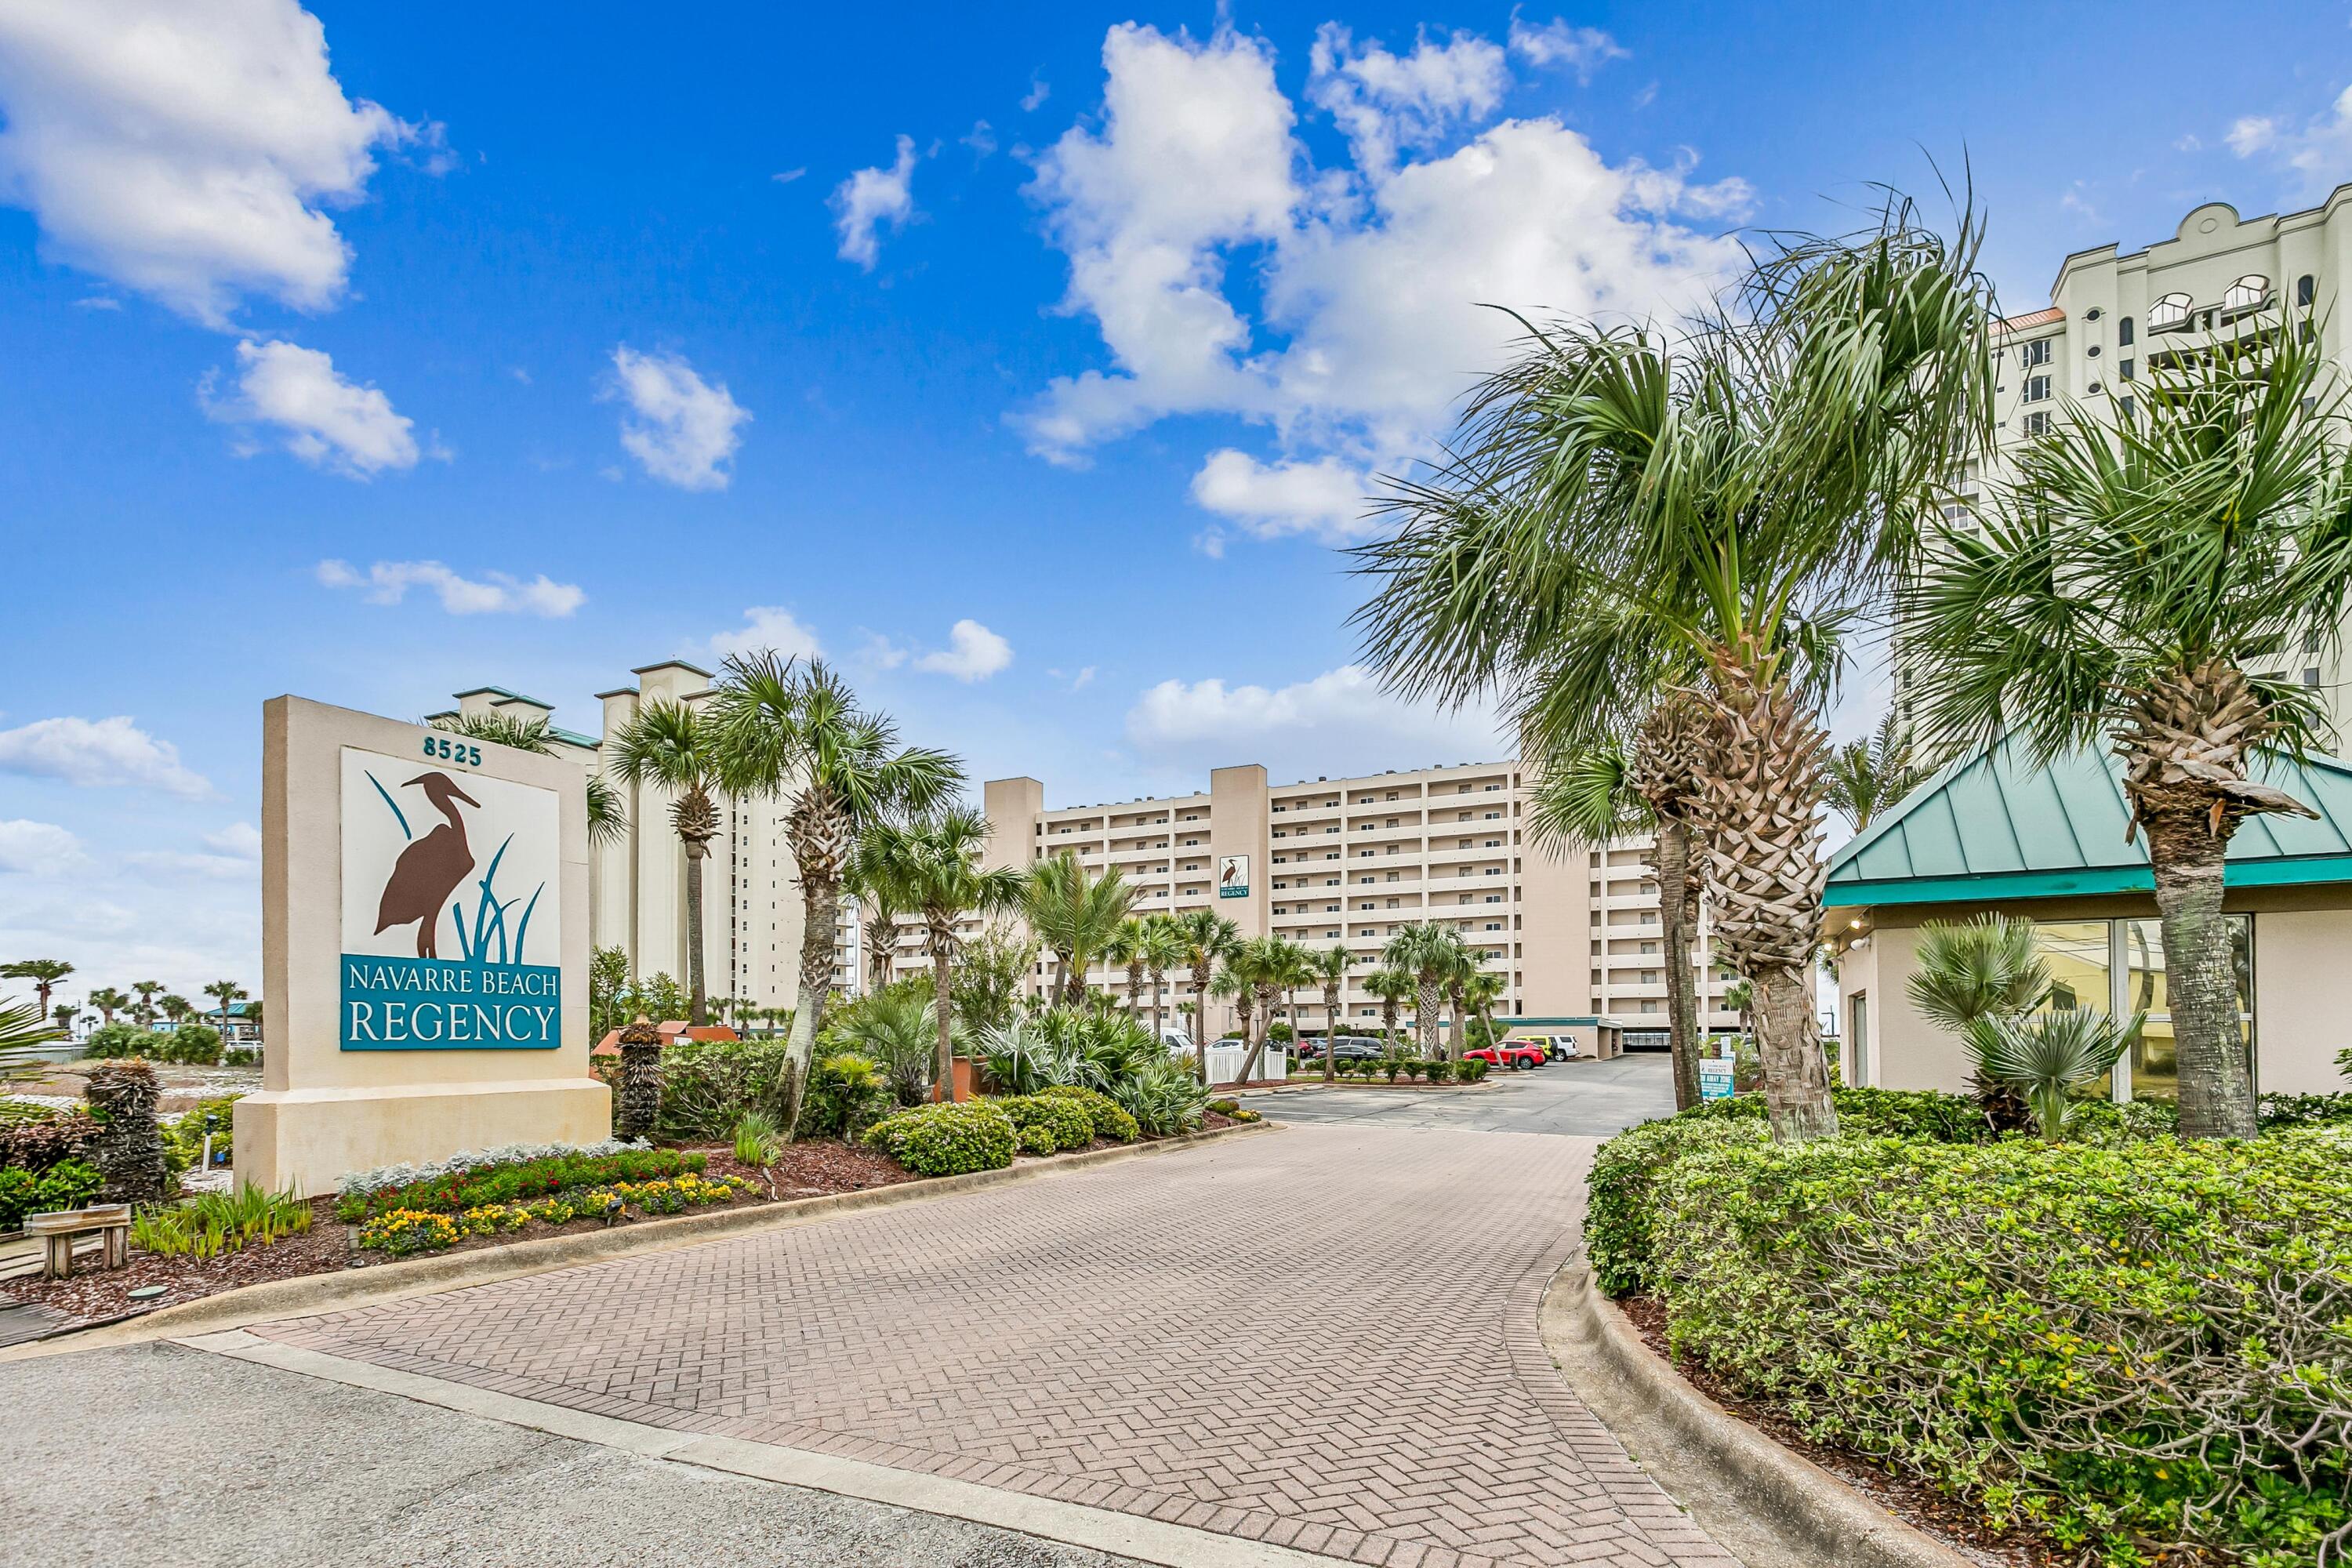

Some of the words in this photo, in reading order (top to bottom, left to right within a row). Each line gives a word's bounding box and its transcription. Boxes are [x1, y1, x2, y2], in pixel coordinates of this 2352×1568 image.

[423, 736, 482, 767] 8525
[349, 964, 473, 993] NAVARRE
[482, 971, 557, 996] BEACH
[348, 1001, 556, 1041] REGENCY
